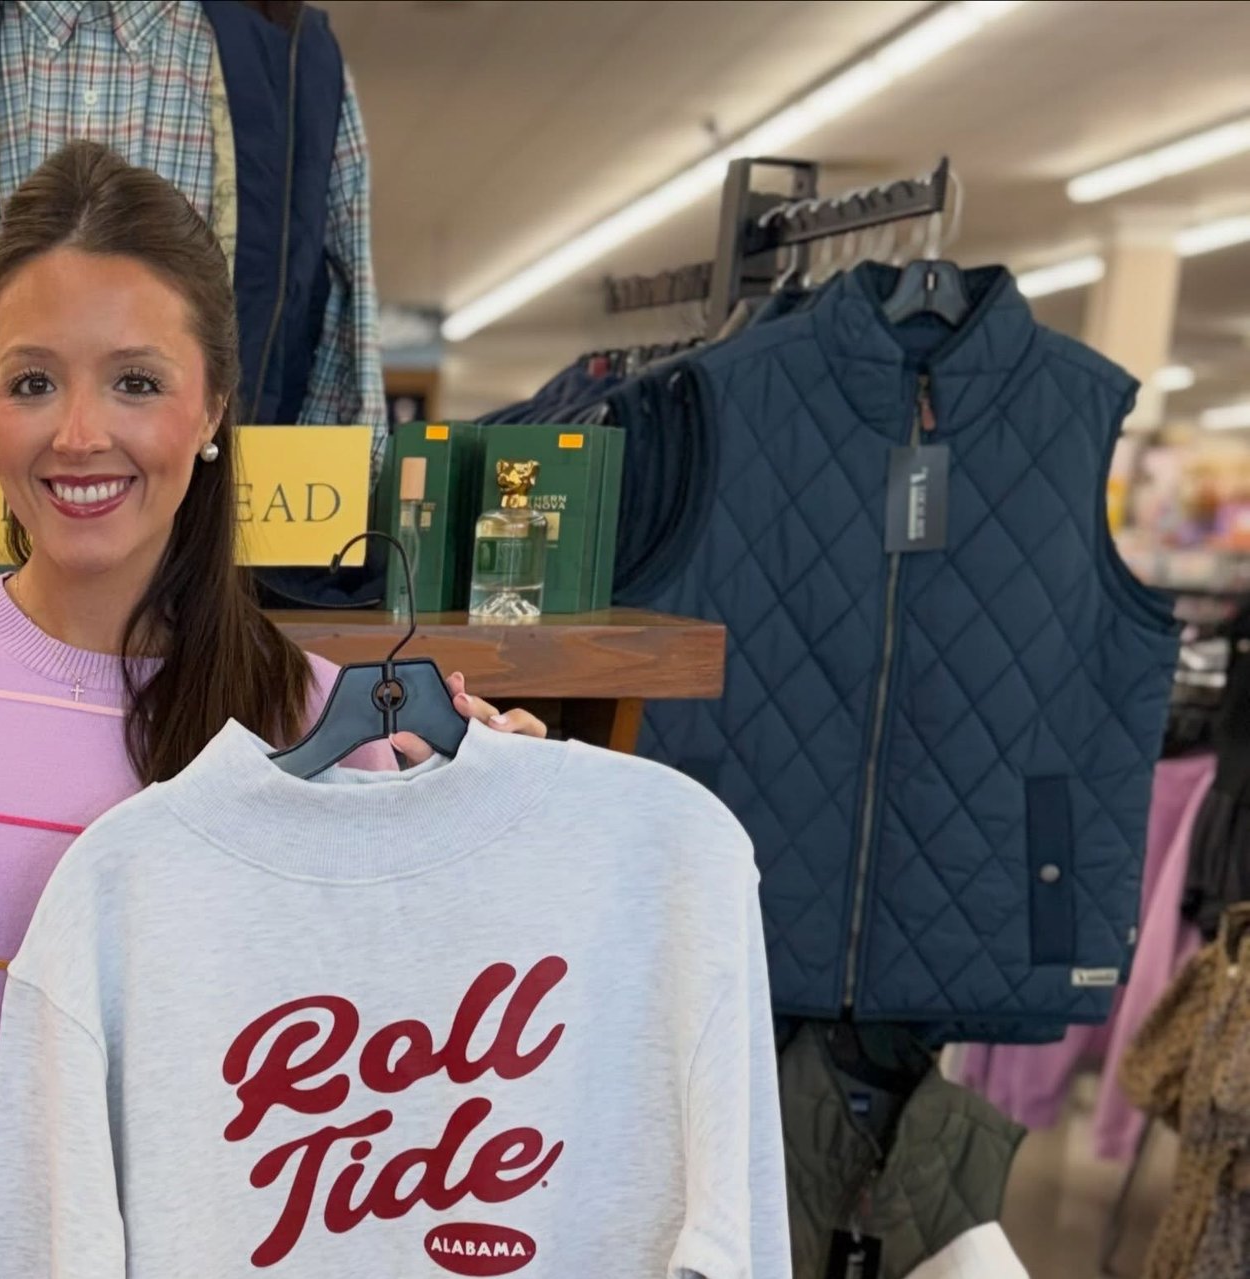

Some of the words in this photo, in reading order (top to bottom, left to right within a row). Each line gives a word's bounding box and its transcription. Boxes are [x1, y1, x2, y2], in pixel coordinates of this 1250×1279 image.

[234, 482, 341, 523] EAD
[222, 955, 568, 1142] Roll
[250, 1097, 564, 1268] Tide
[431, 1236, 526, 1257] ALABAMA
